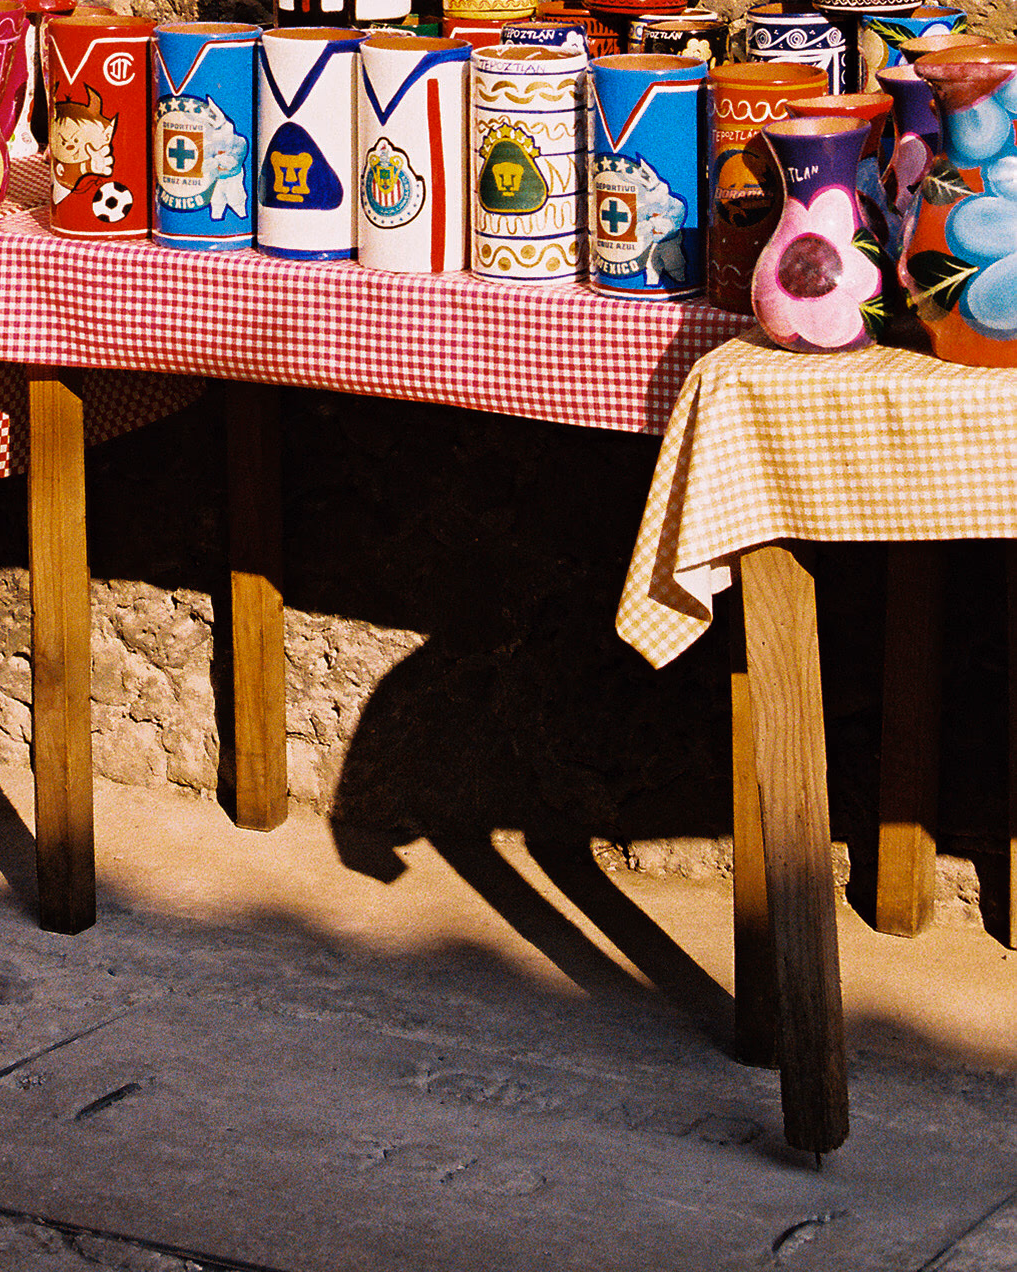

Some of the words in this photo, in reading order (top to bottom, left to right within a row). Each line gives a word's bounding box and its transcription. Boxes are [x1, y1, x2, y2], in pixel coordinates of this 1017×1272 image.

[163, 121, 204, 132] DEPORTIVO
[163, 177, 181, 185] CRUZ
[182, 178, 202, 187] AZUL
[596, 181, 636, 193] DEPORTIVO
[160, 190, 205, 210] MEXICO
[597, 240, 613, 250] CRUZ
[615, 242, 636, 251] AZUL
